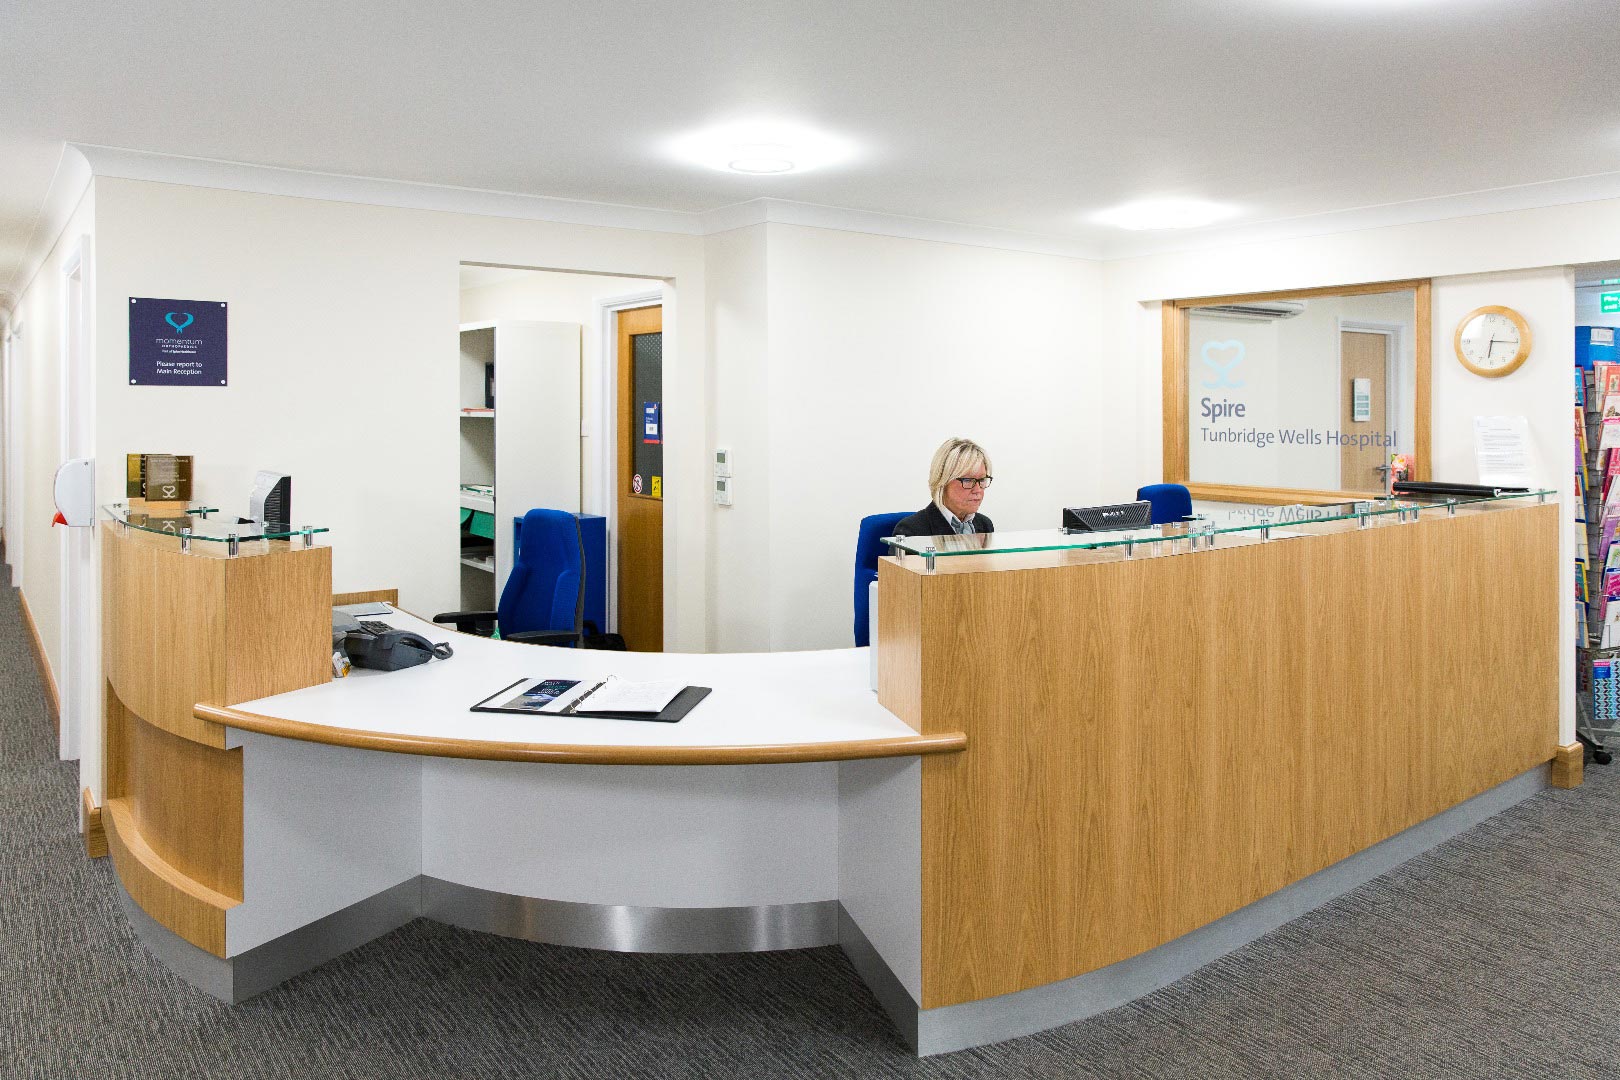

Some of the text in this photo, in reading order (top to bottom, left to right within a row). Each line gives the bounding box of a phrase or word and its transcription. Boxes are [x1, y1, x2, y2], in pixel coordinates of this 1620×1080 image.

[173, 368, 202, 376] Reception
[176, 361, 195, 369] report
[1201, 397, 1246, 423] Spire
[1201, 427, 1397, 451] Tunbridge Wells Hospital
